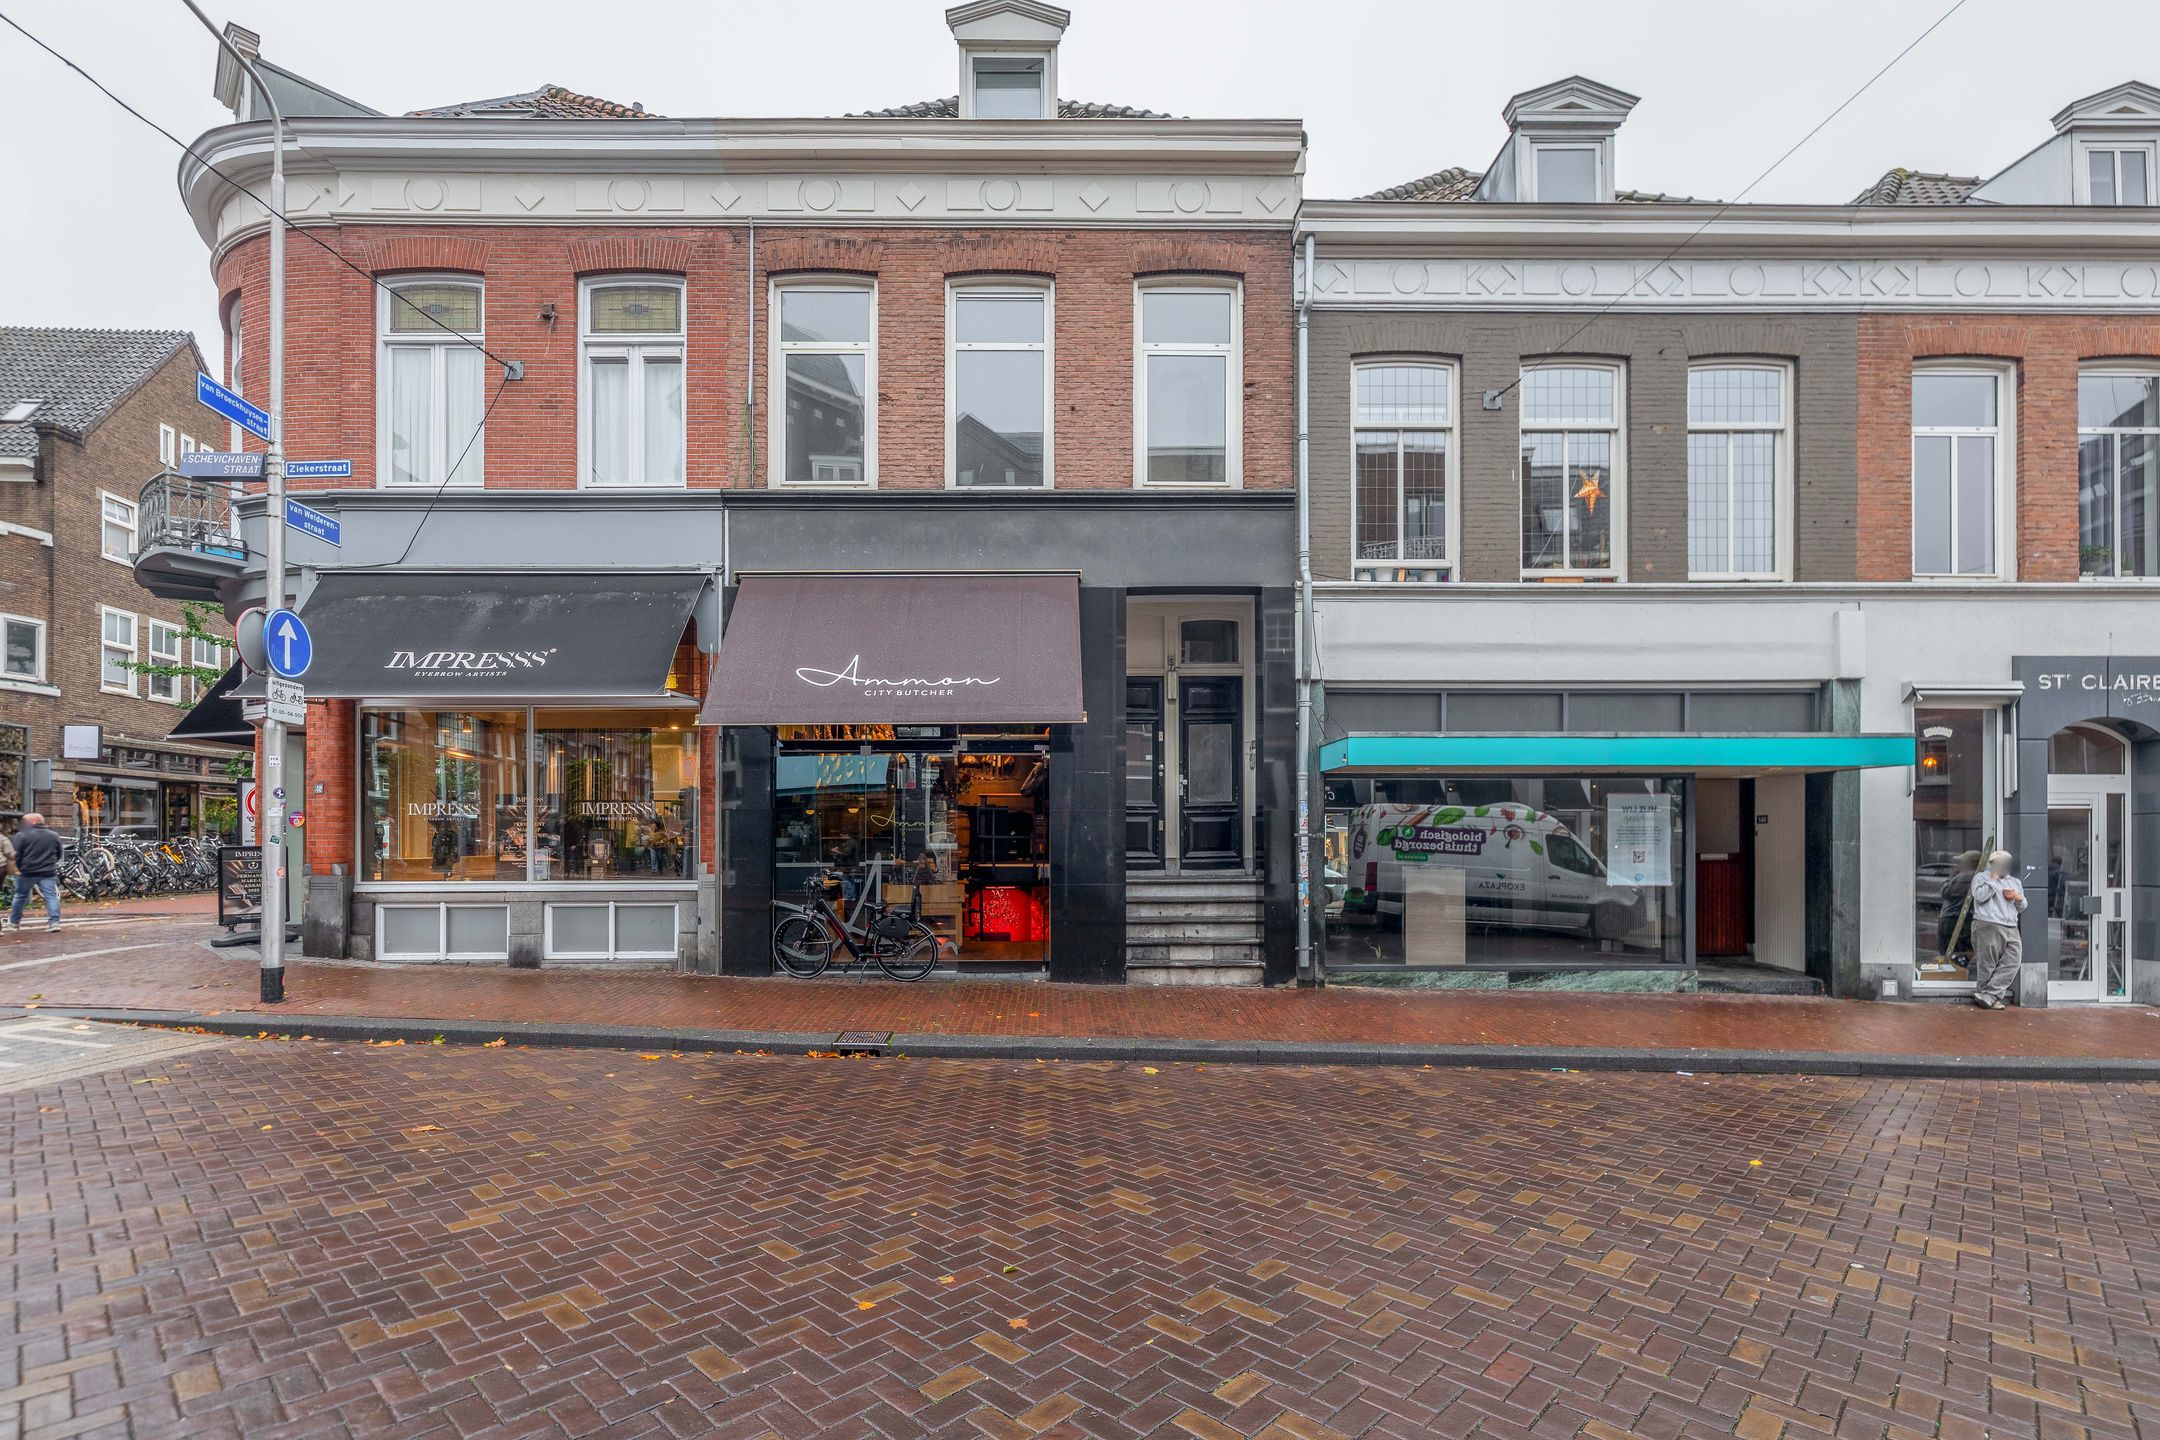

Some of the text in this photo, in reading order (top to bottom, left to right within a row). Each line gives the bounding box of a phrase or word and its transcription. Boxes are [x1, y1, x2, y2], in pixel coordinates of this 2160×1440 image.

[200, 381, 215, 393] van
[246, 418, 268, 435] straat
[223, 465, 260, 474] STRAAT
[289, 464, 347, 473] Ziekerstraat
[289, 504, 303, 516] van
[303, 521, 325, 536] straat
[796, 654, 1000, 686] Ammon
